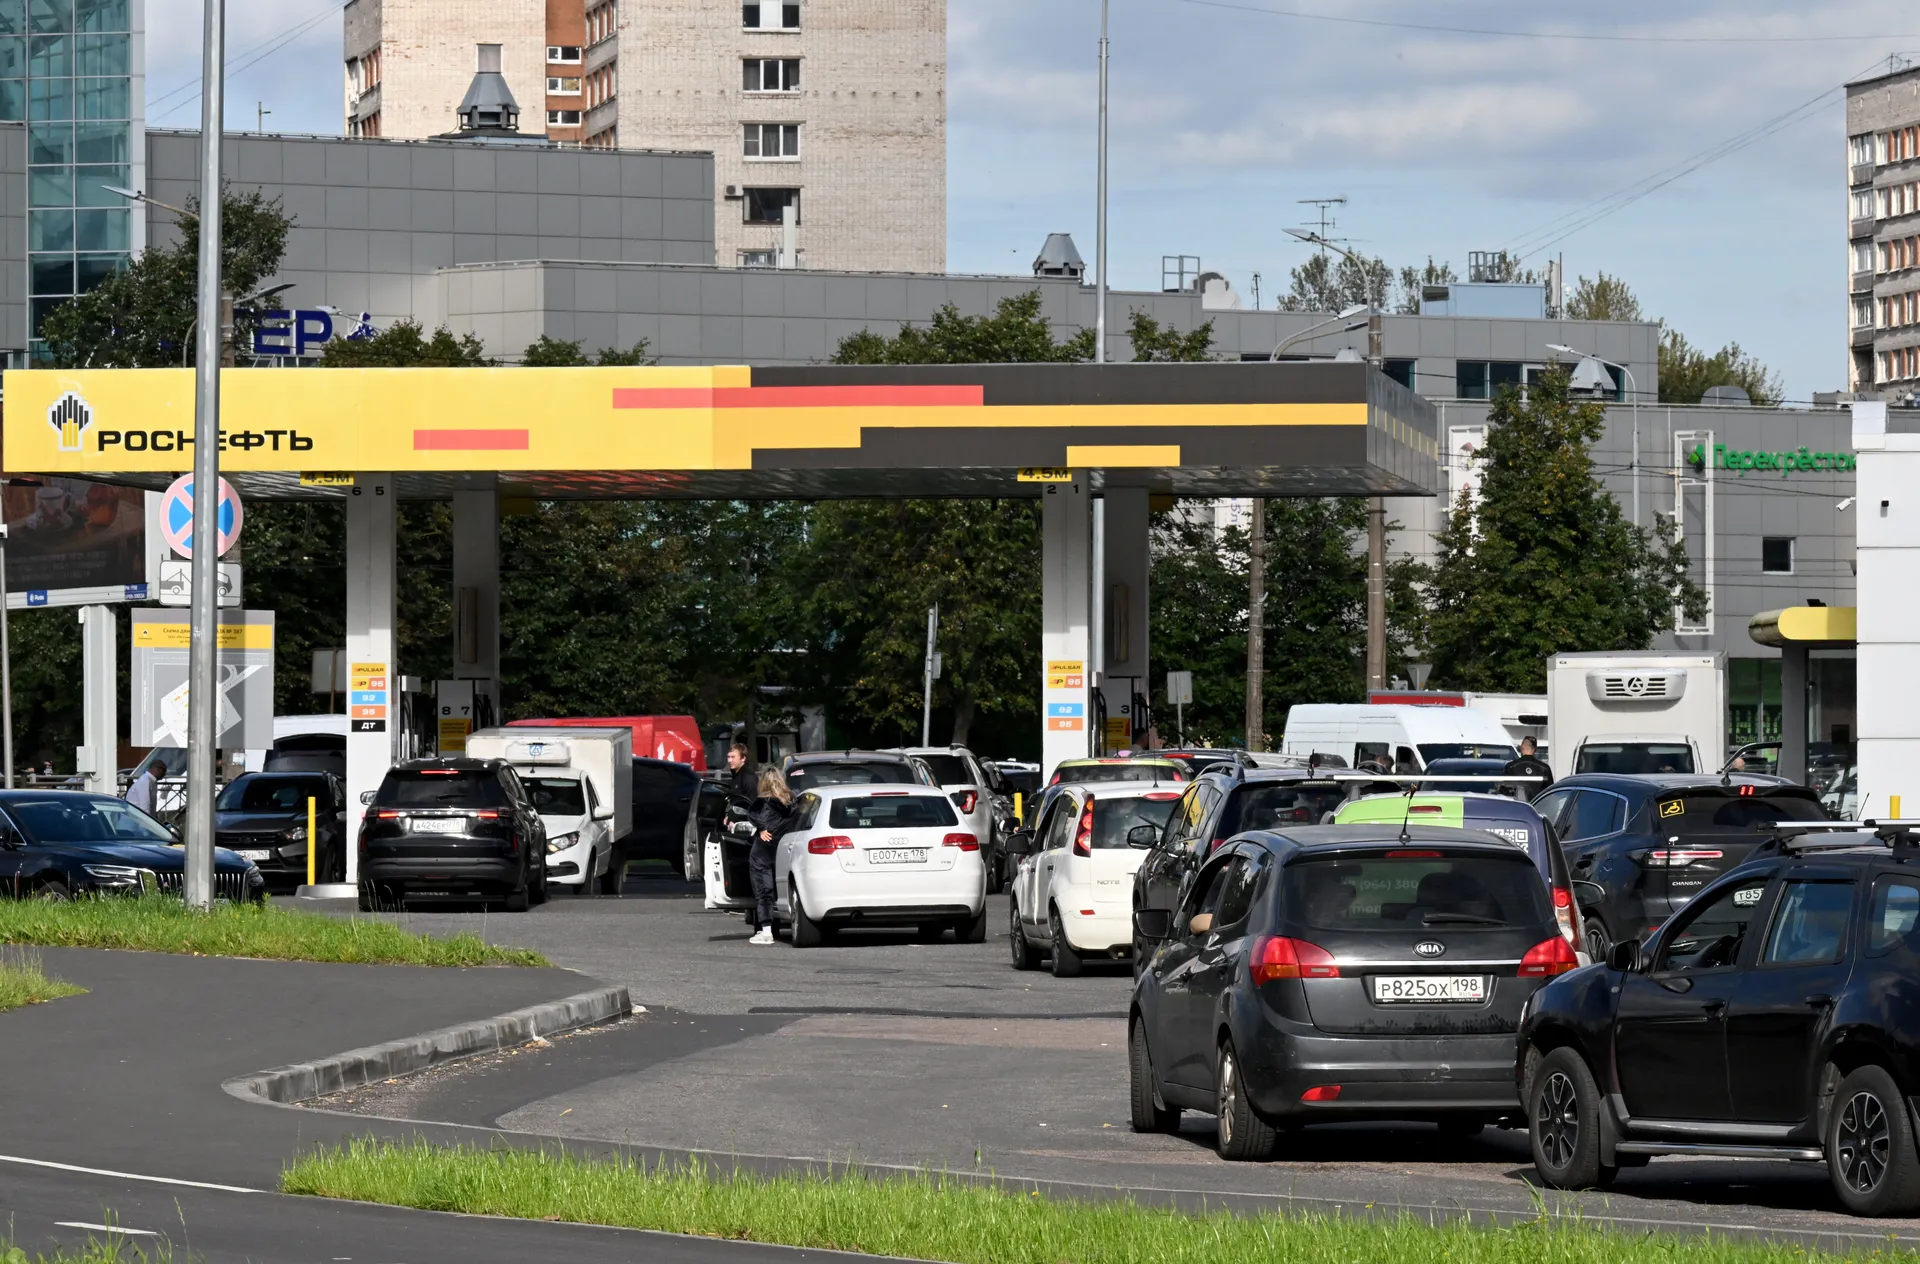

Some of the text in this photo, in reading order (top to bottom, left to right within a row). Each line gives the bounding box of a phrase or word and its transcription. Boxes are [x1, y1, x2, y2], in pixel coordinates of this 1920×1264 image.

[352, 486, 385, 496] 6 5
[1047, 484, 1079, 494] 2 1
[441, 706, 470, 715] 8 7
[1121, 704, 1130, 714] 3
[361, 722, 376, 730] ДТ
[1058, 720, 1072, 728] 95
[872, 849, 925, 860] Е007КЕ 178
[1420, 945, 1440, 953] KIA
[1382, 979, 1478, 997] Р825ОХ 198
